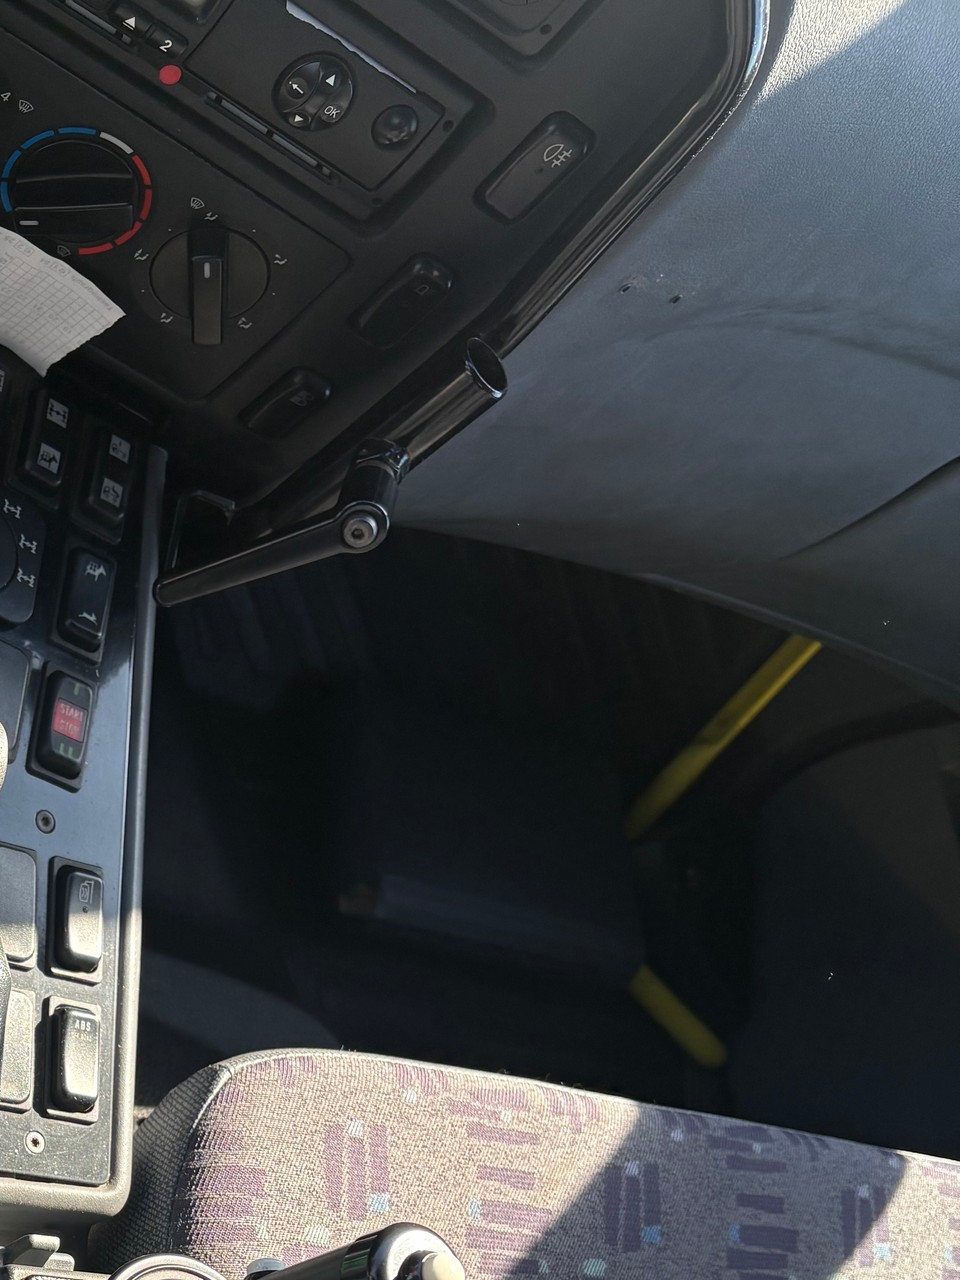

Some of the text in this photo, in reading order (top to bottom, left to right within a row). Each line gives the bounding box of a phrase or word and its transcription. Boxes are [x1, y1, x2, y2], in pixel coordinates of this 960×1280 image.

[159, 39, 172, 52] 2
[0, 91, 12, 102] 4
[324, 105, 341, 119] OK
[74, 1019, 91, 1032] ABS
